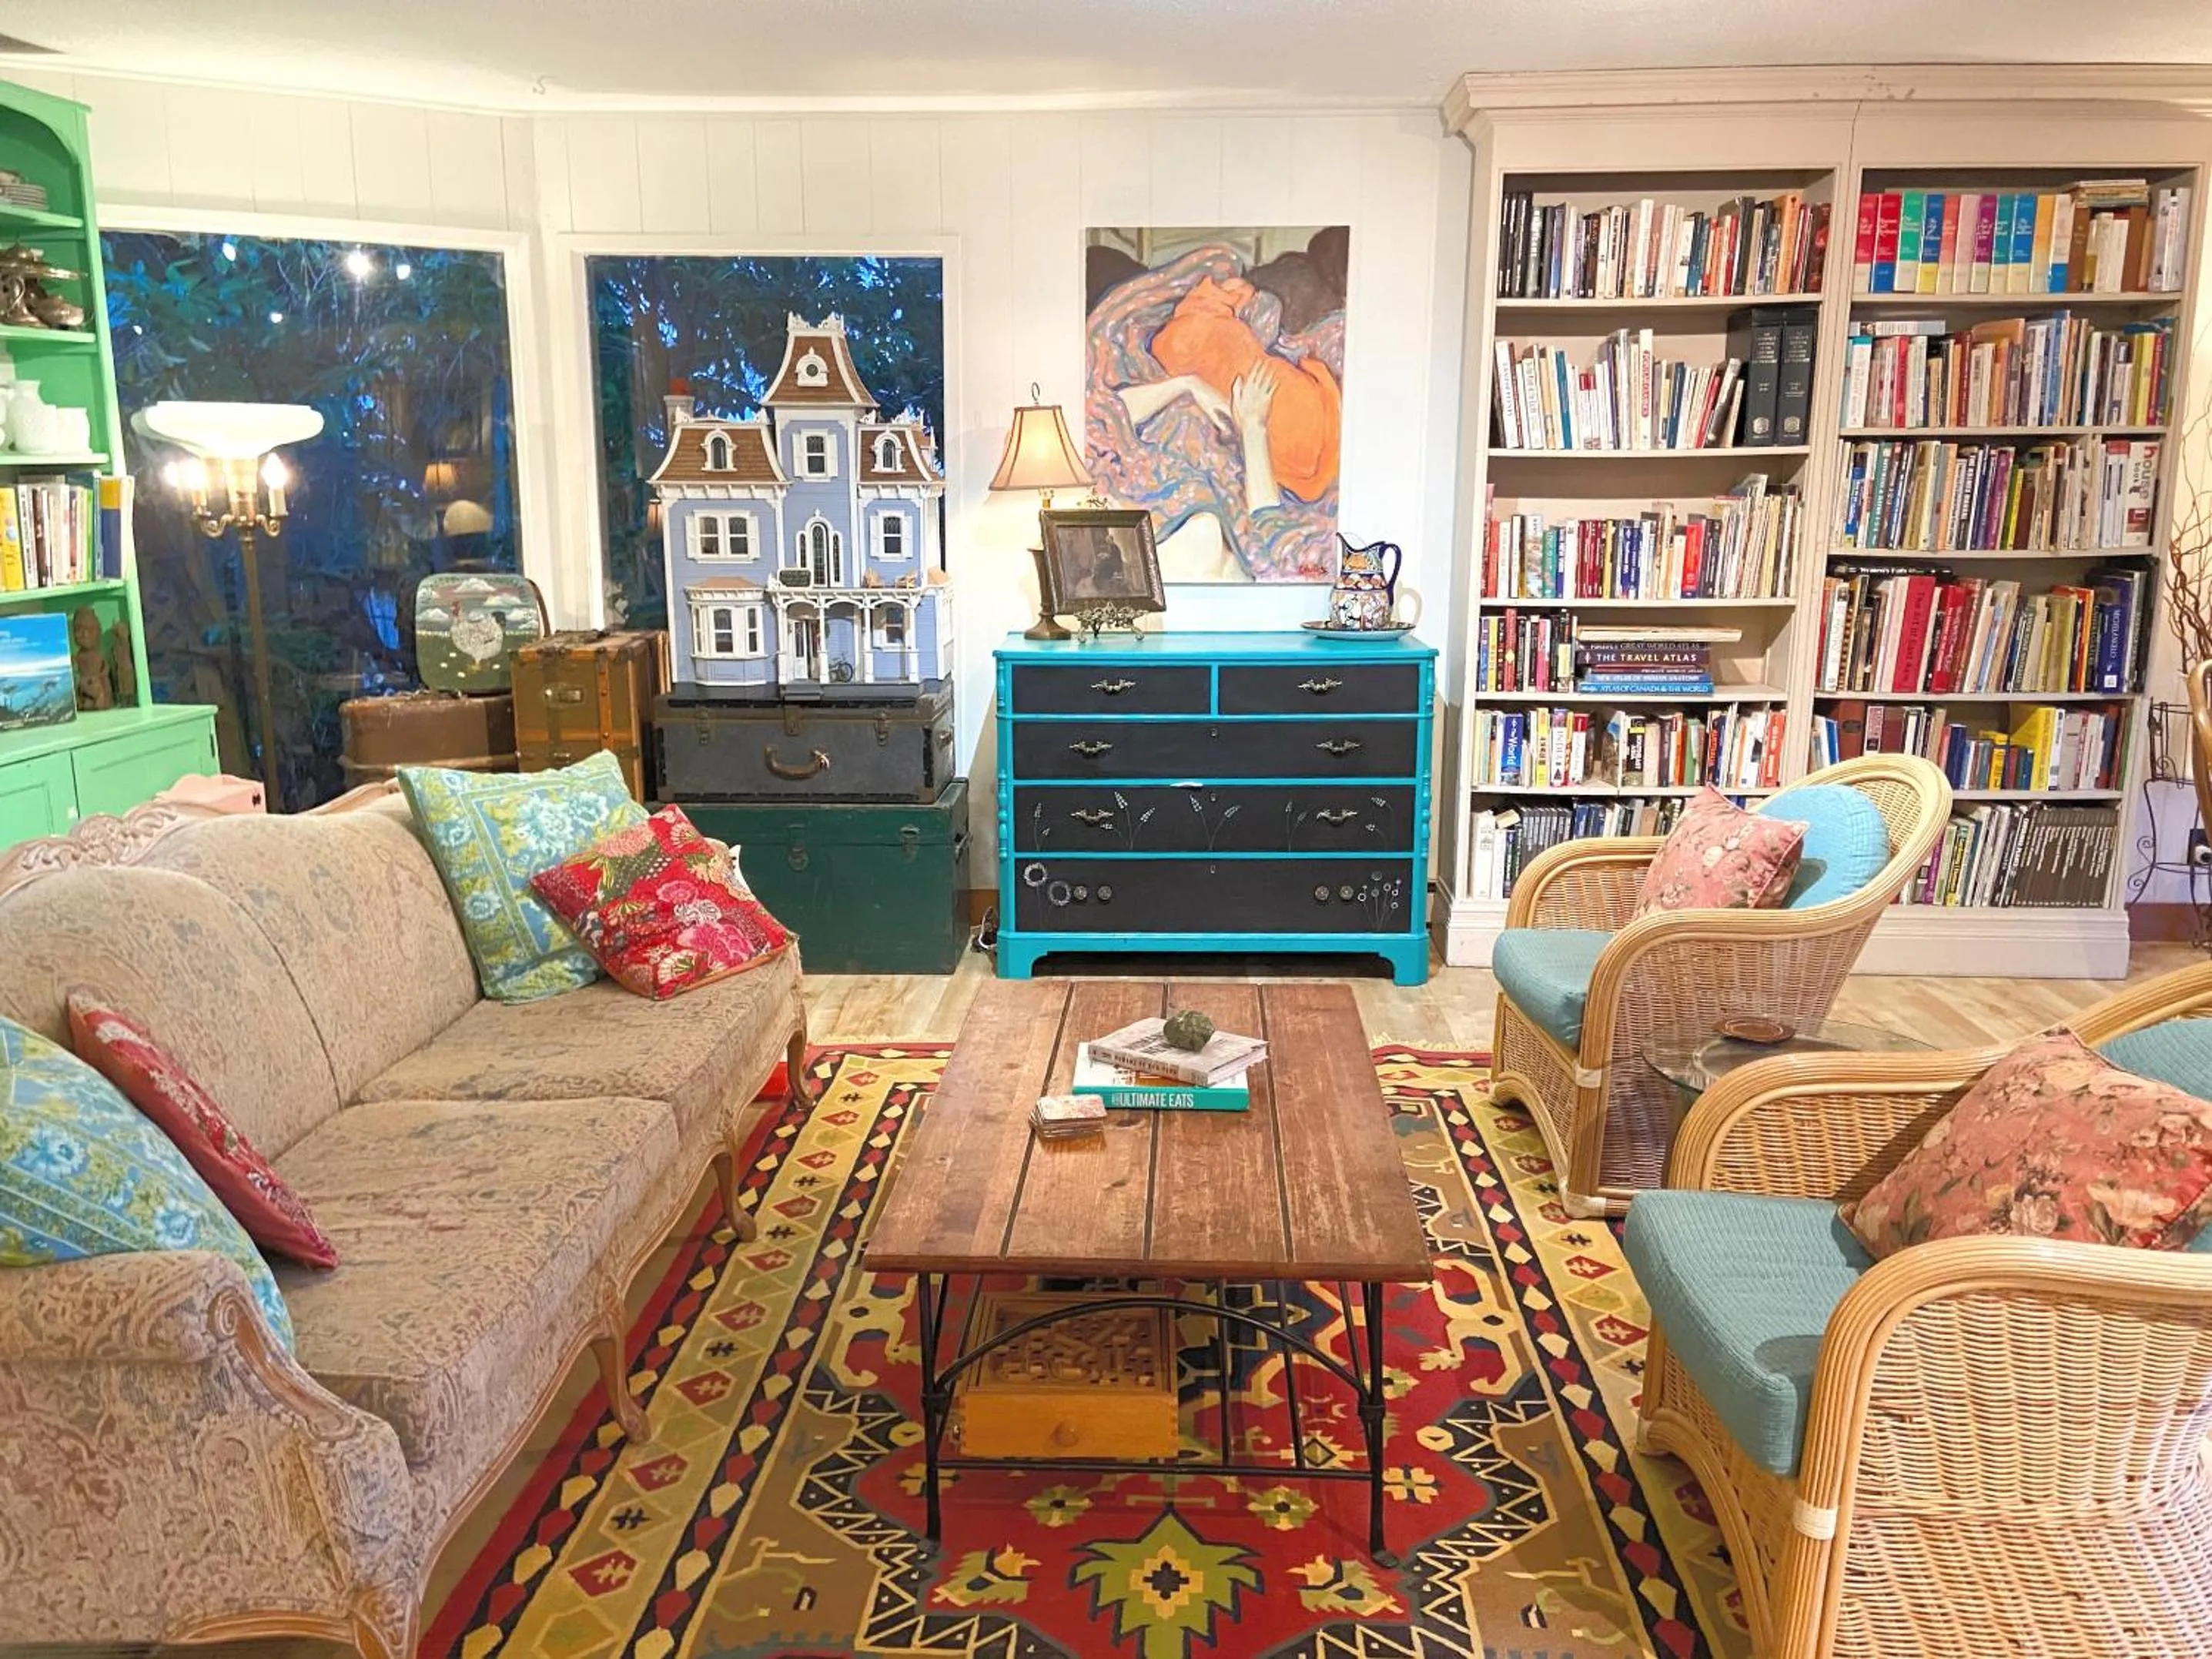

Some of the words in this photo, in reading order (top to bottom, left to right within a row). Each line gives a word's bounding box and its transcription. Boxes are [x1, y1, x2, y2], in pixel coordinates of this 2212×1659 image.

[2140, 446, 2159, 499] house
[1597, 653, 1616, 662] THE
[1620, 653, 1659, 662] TRAVEL
[1663, 653, 1697, 662] ATLAS
[1506, 737, 1518, 765] World
[1119, 1092, 1167, 1107] ULTIMATE
[1169, 1092, 1194, 1108] EATS
